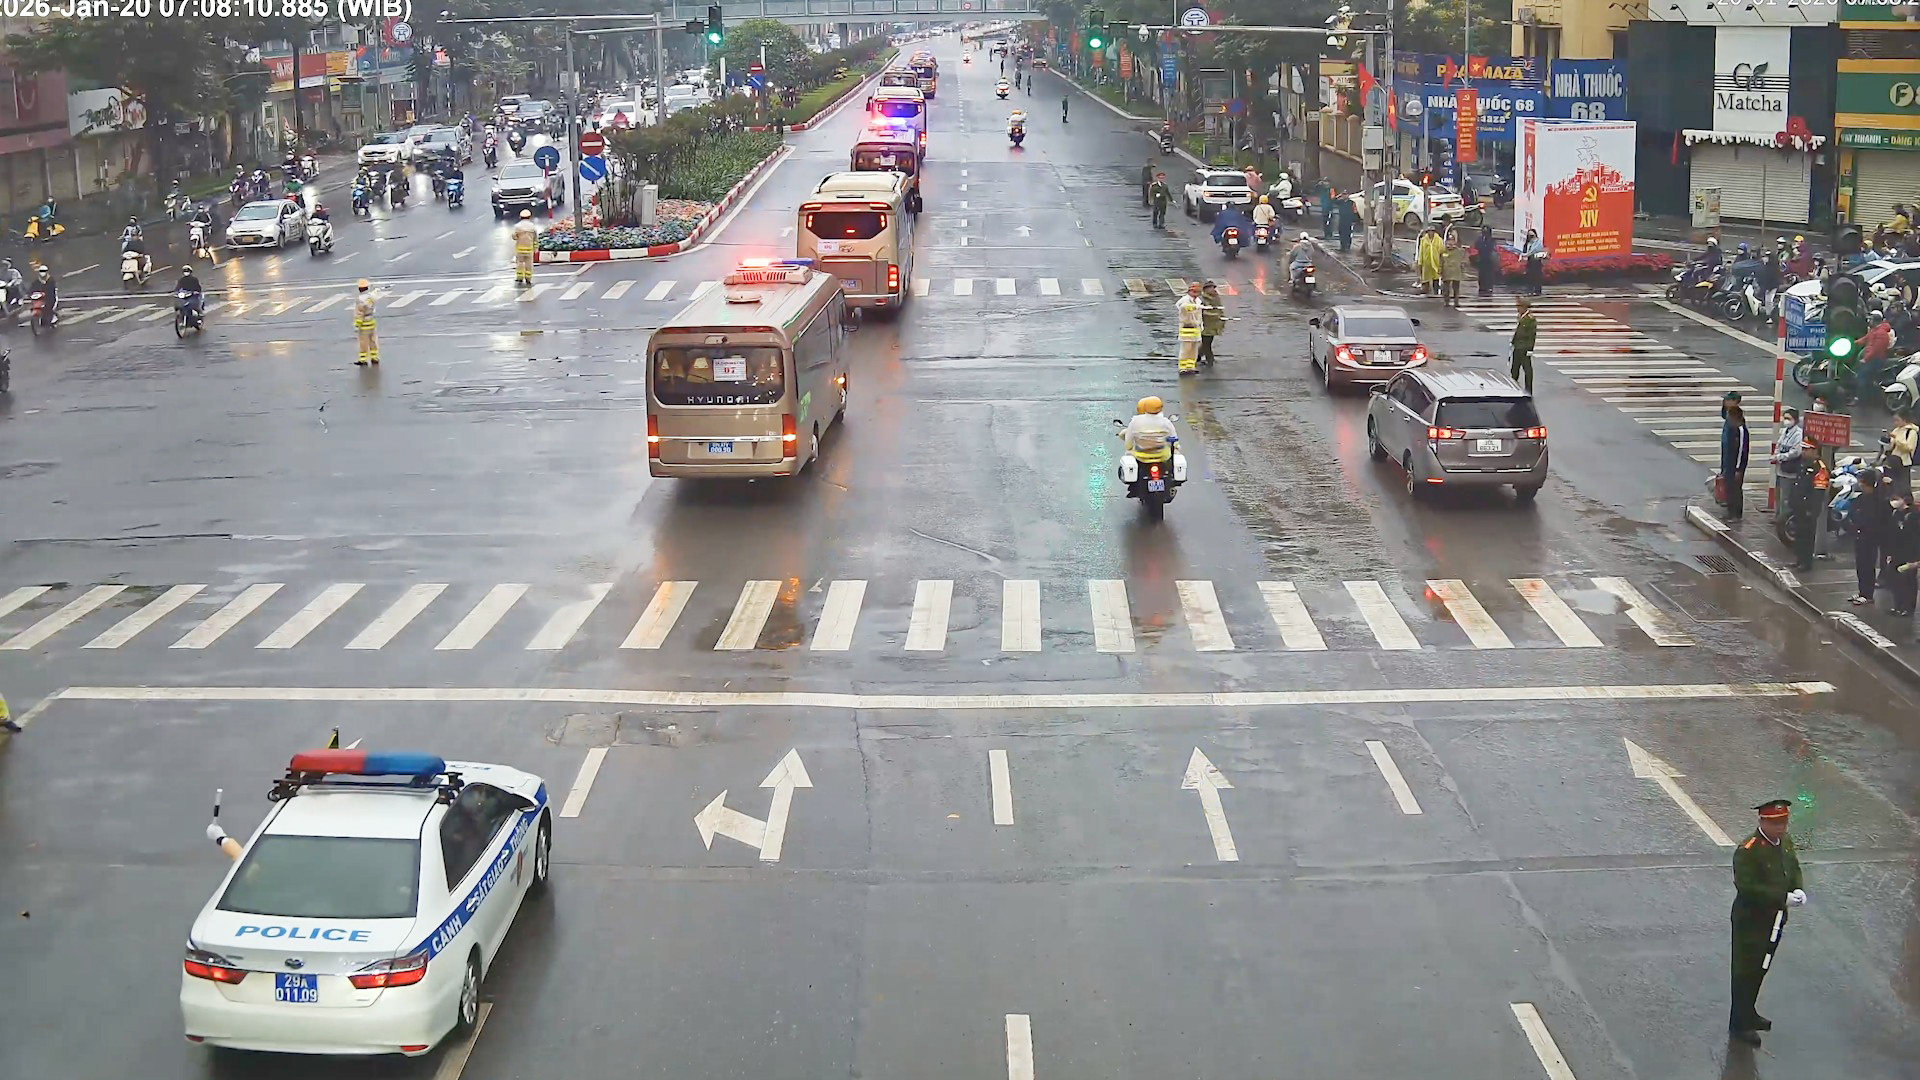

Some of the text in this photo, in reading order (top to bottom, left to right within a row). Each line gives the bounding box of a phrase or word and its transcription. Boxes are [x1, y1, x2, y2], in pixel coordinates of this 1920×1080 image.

[1555, 65, 1622, 97] NHÀ THUỐC
[1515, 99, 1535, 112] 68
[1571, 101, 1605, 120] 68
[1717, 92, 1783, 112] Matcha
[1855, 134, 1882, 144] NHANH
[1580, 209, 1599, 228] XIV
[687, 395, 750, 404] HYUNDAI
[235, 925, 372, 943] POLICE
